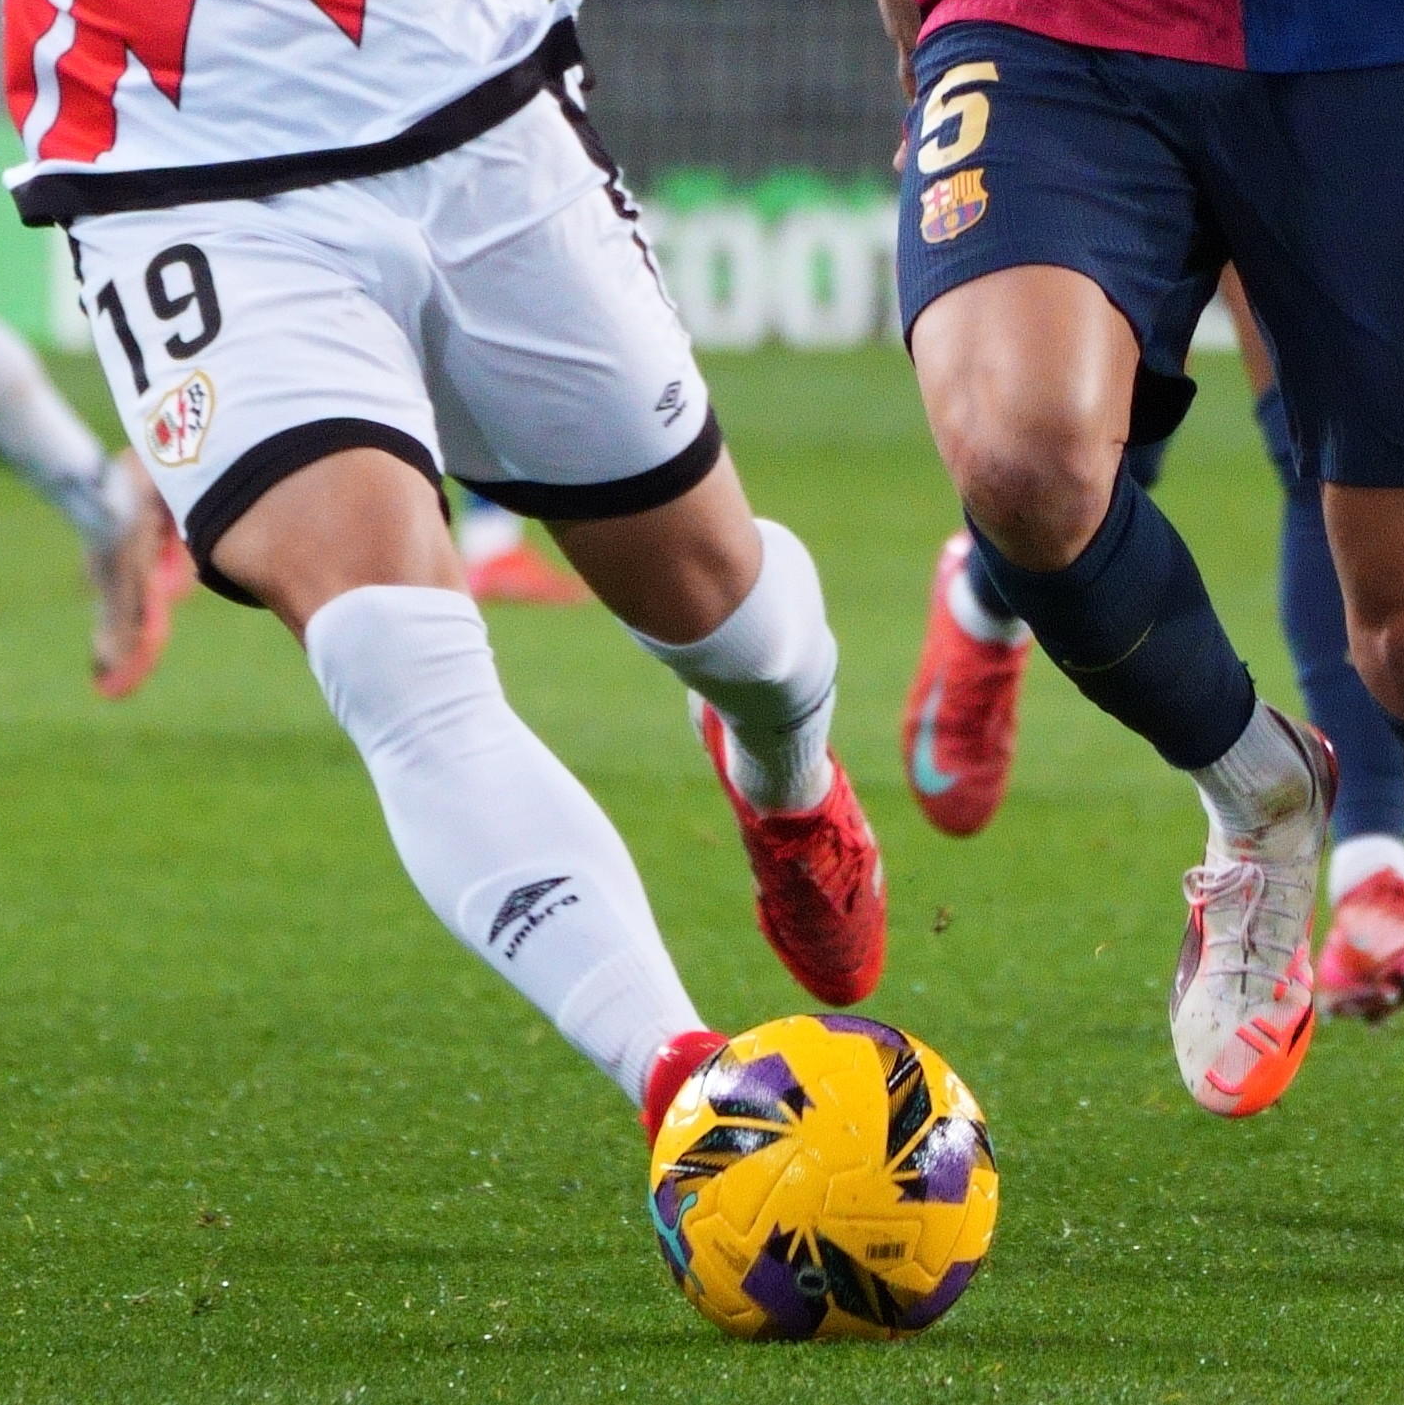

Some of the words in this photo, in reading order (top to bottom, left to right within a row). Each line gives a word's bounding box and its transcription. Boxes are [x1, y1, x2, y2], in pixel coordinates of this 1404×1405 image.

[917, 61, 999, 175] 5
[96, 242, 222, 396] 19
[504, 894, 579, 961] umbro
